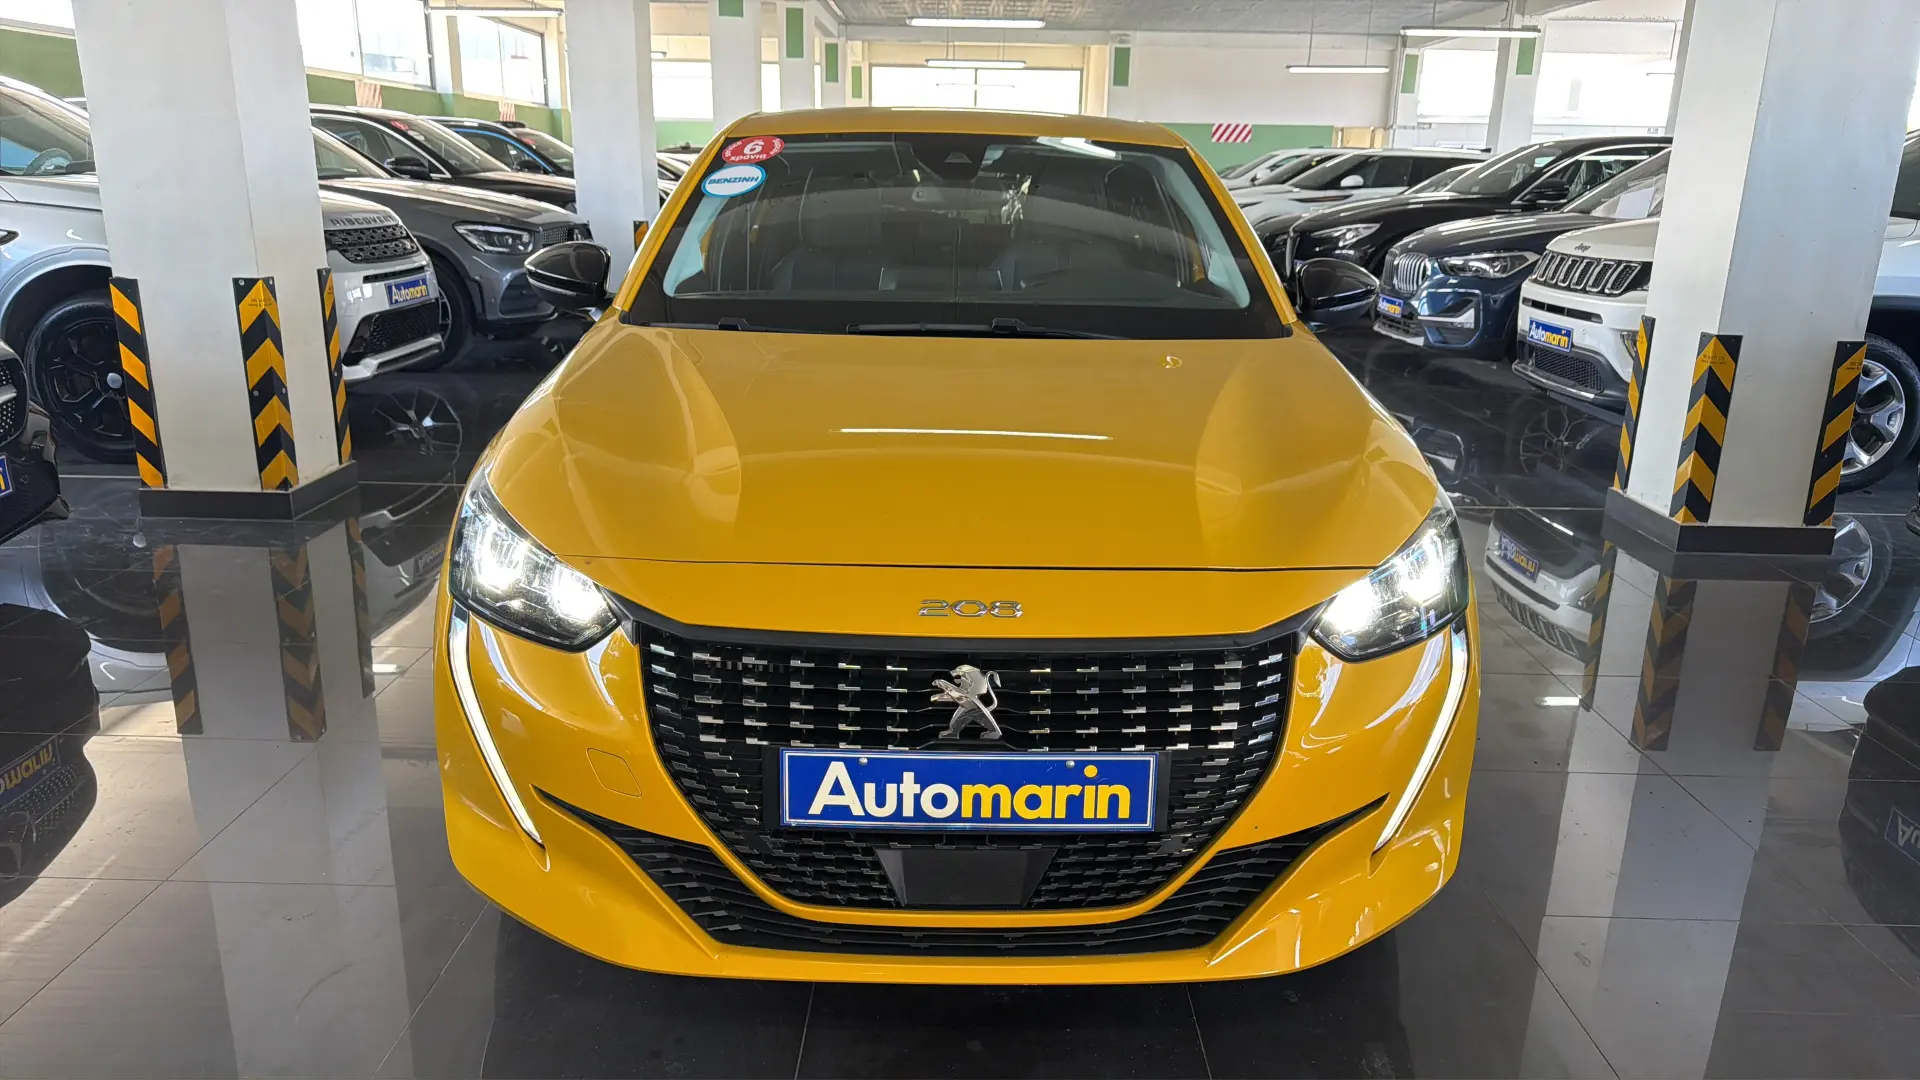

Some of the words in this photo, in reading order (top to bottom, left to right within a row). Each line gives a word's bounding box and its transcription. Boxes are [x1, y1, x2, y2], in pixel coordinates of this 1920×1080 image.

[743, 141, 765, 155] 6
[392, 280, 428, 303] Automarin
[1529, 321, 1569, 348] Automarin
[918, 599, 1024, 618] 208
[808, 761, 1131, 820] Automarin
